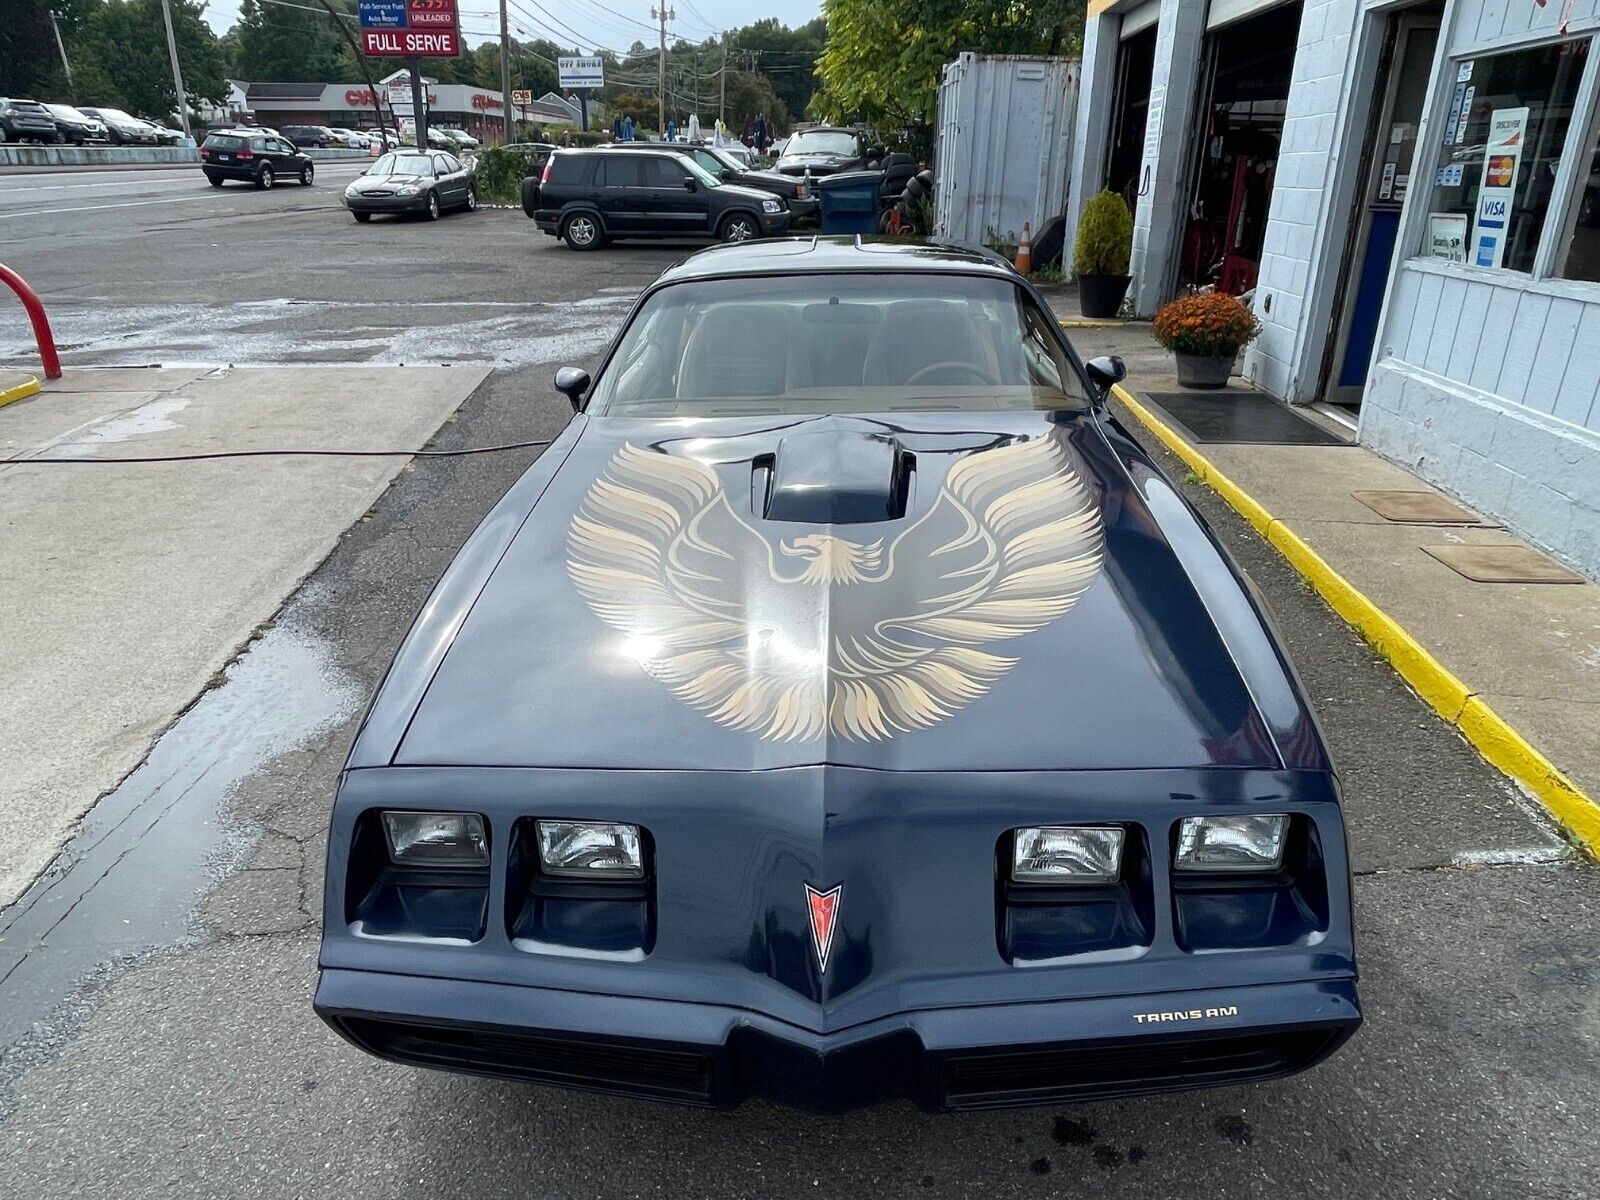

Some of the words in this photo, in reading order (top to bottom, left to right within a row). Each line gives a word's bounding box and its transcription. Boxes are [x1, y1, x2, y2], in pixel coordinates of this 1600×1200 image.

[411, 14, 451, 22] UNLEADED
[367, 34, 402, 50] FULL
[406, 34, 452, 51] SERVE
[513, 91, 530, 99] CVS
[1496, 119, 1521, 130] DISCOVER
[1484, 201, 1506, 216] VISA
[1133, 1010, 1202, 1023] TRANS
[1206, 1007, 1238, 1017] AM
